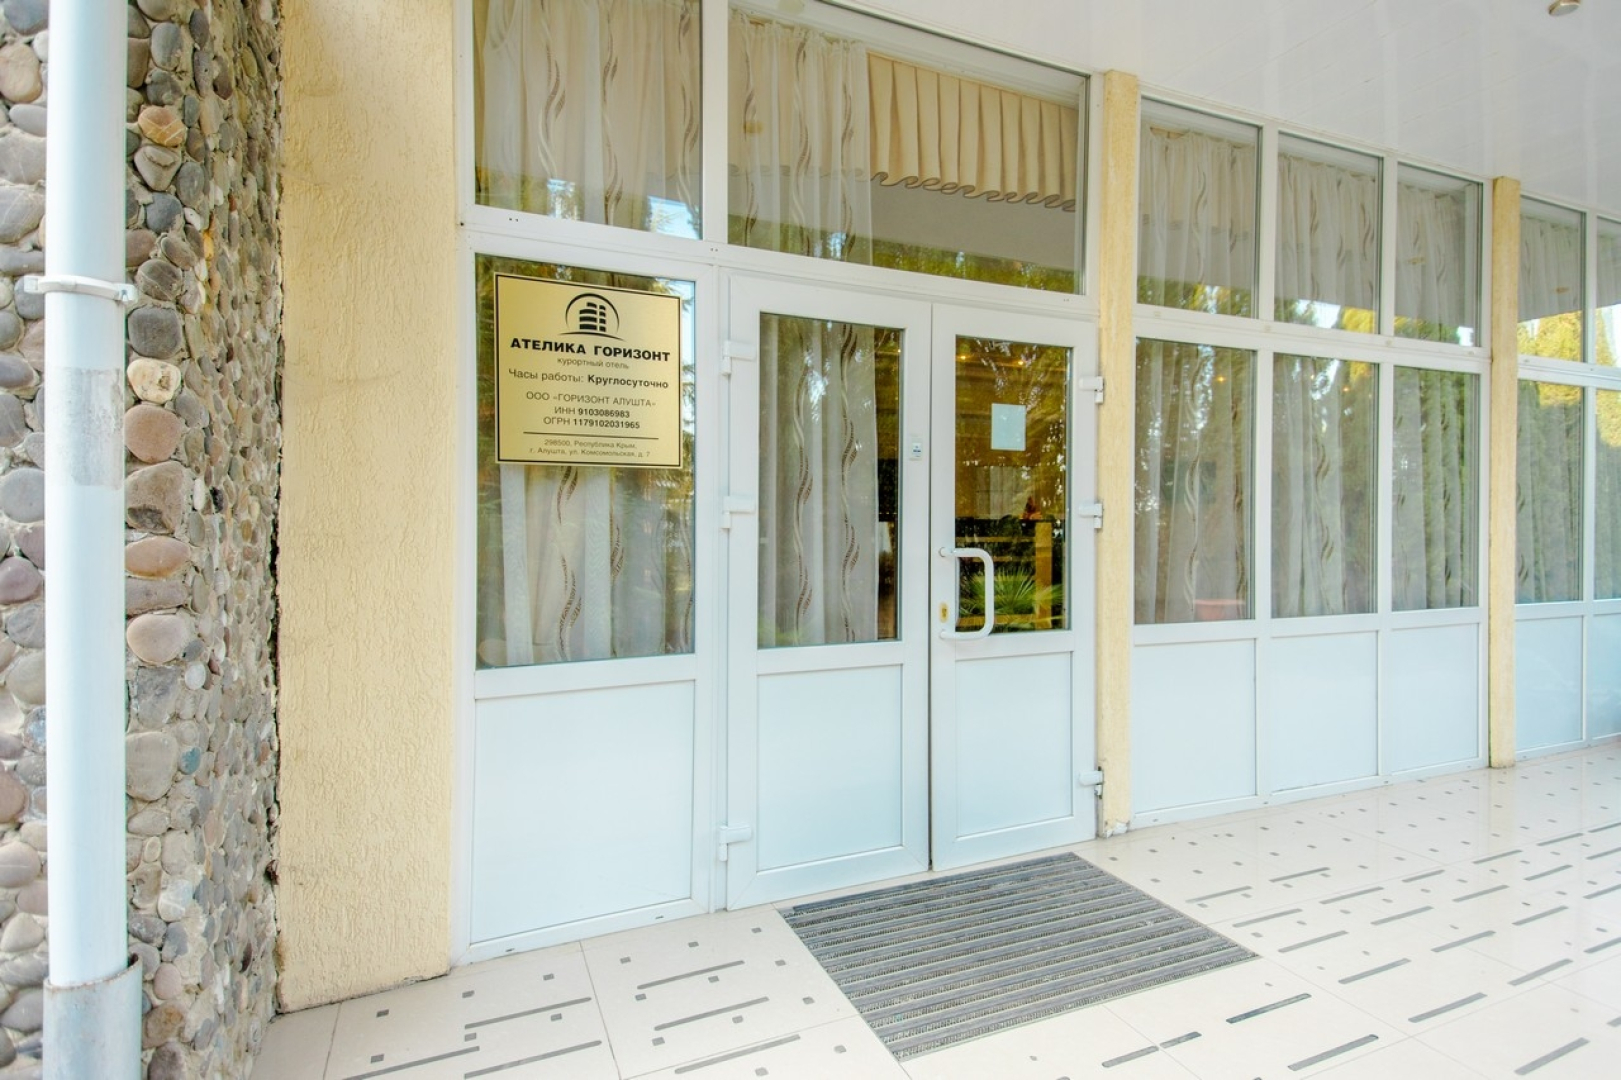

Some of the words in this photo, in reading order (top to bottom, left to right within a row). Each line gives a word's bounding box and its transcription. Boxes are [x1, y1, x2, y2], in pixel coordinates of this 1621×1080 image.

[510, 337, 587, 355] АТЕЛИКА
[593, 345, 671, 362] ГОРИЗОНТ
[557, 357, 604, 367] курортный
[605, 361, 629, 370] отель
[508, 368, 538, 379] Часы
[541, 371, 583, 384] работы:
[587, 374, 669, 389] Круглосуточно
[526, 391, 550, 401] ООО
[554, 406, 576, 415] ИНН
[578, 408, 630, 418] 9103086983
[543, 416, 571, 425] ОГРН
[573, 418, 640, 429] 1179102031965
[574, 440, 614, 448] Республика
